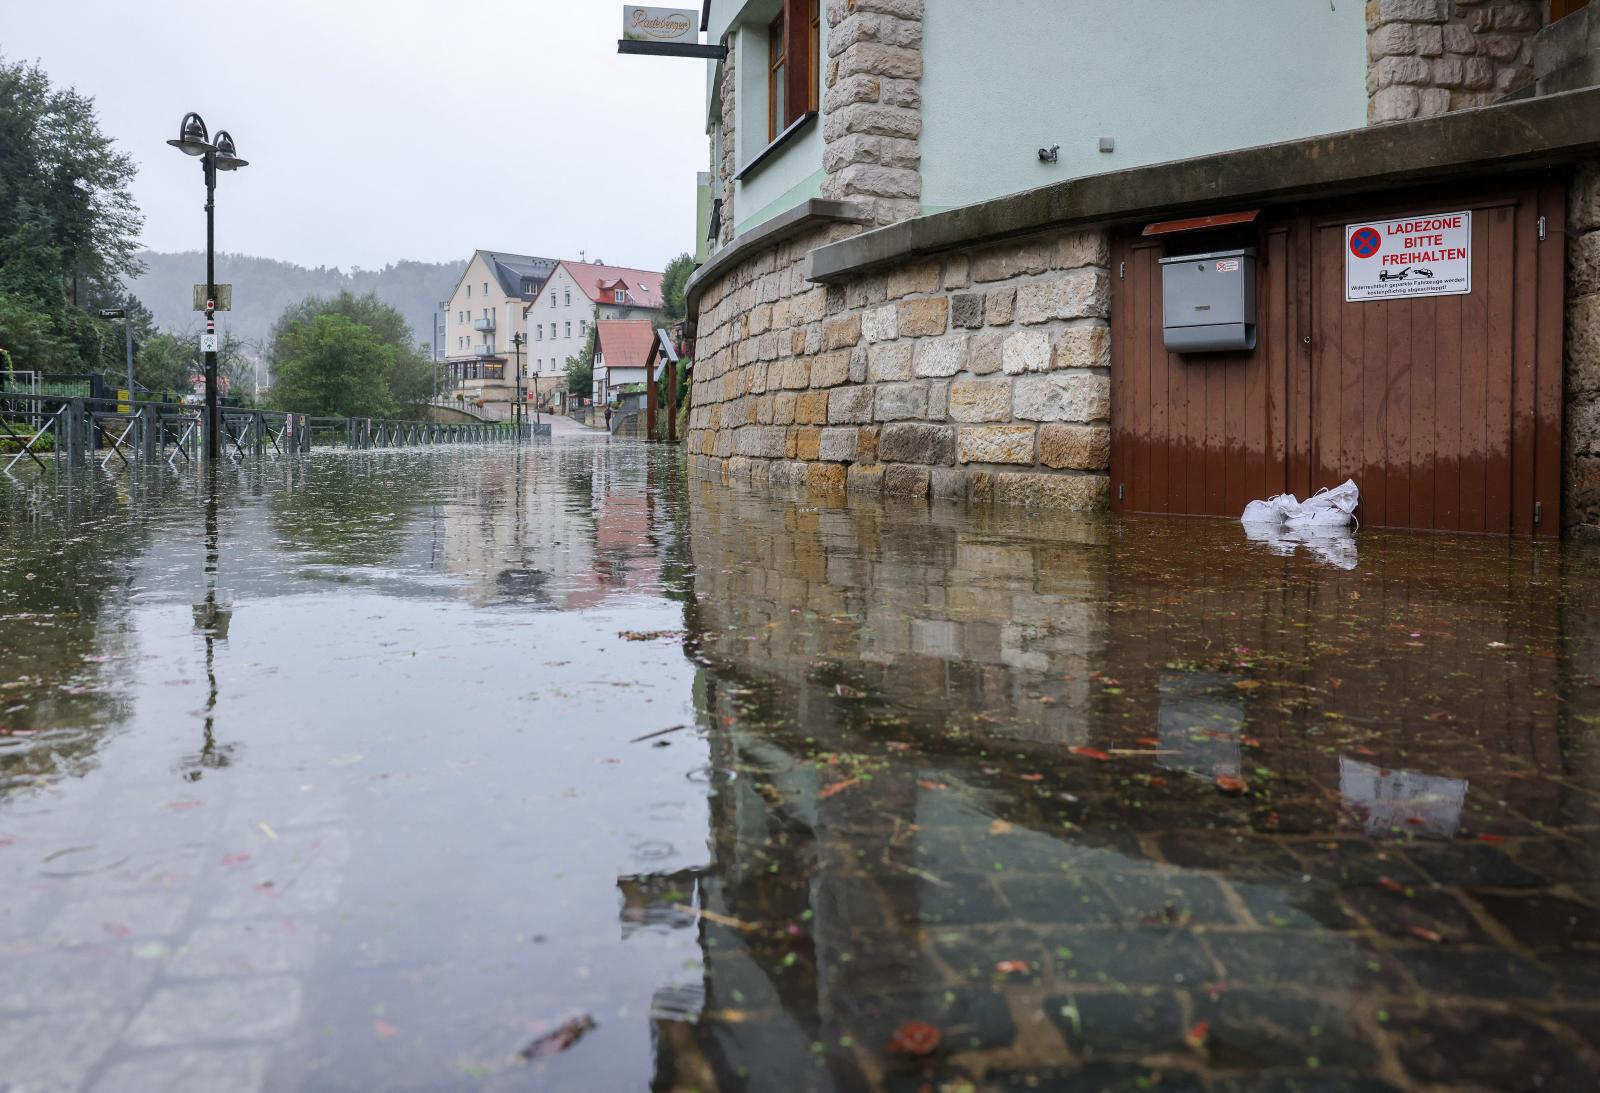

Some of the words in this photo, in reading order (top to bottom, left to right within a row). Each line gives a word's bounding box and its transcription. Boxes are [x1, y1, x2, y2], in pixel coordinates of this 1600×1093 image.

[1387, 217, 1461, 235] LADEZONE
[1404, 234, 1443, 248] BITTE
[1382, 248, 1466, 266] FREIHALTEN
[1367, 287, 1406, 295] kostenpflichtig
[1389, 281, 1413, 289] geparkte
